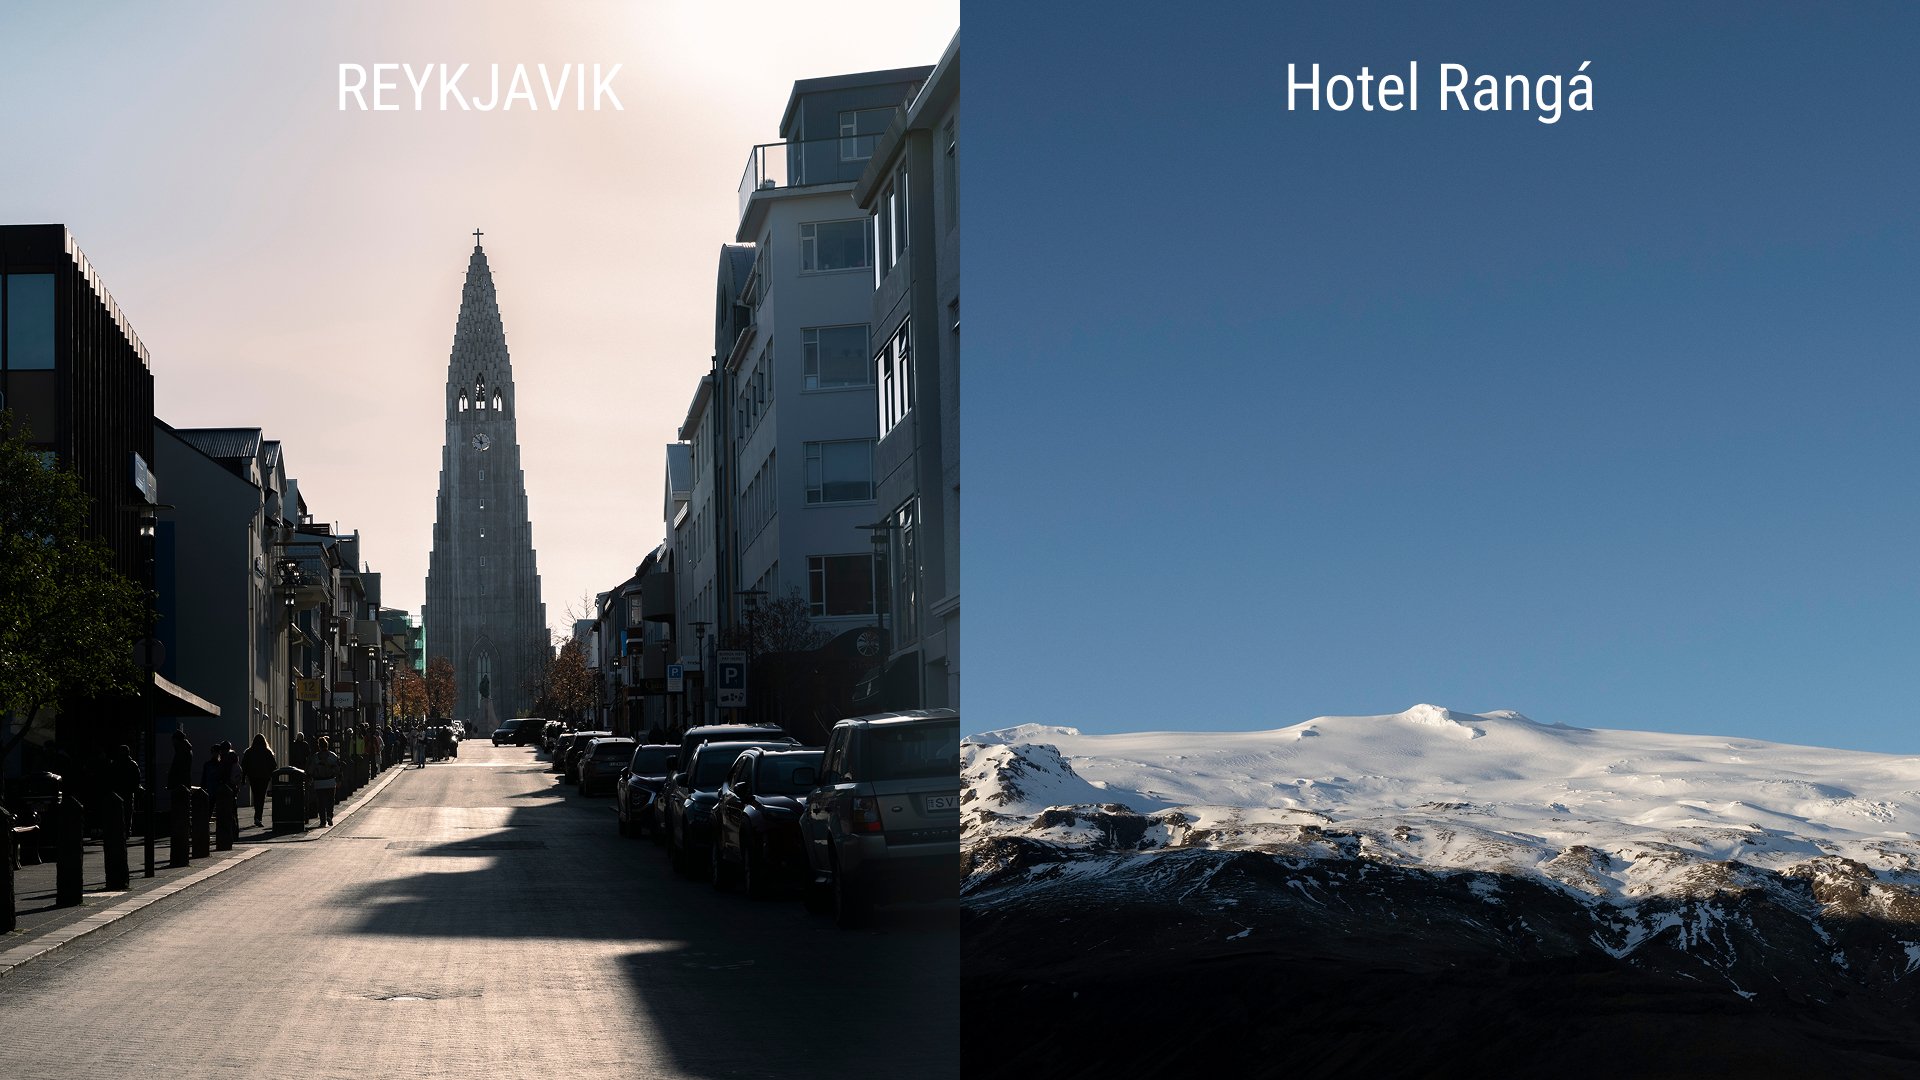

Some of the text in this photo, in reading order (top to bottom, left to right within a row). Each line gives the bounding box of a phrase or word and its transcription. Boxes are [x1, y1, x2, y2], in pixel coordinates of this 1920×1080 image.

[671, 668, 679, 677] P
[725, 667, 738, 684] P
[303, 681, 315, 692] 12
